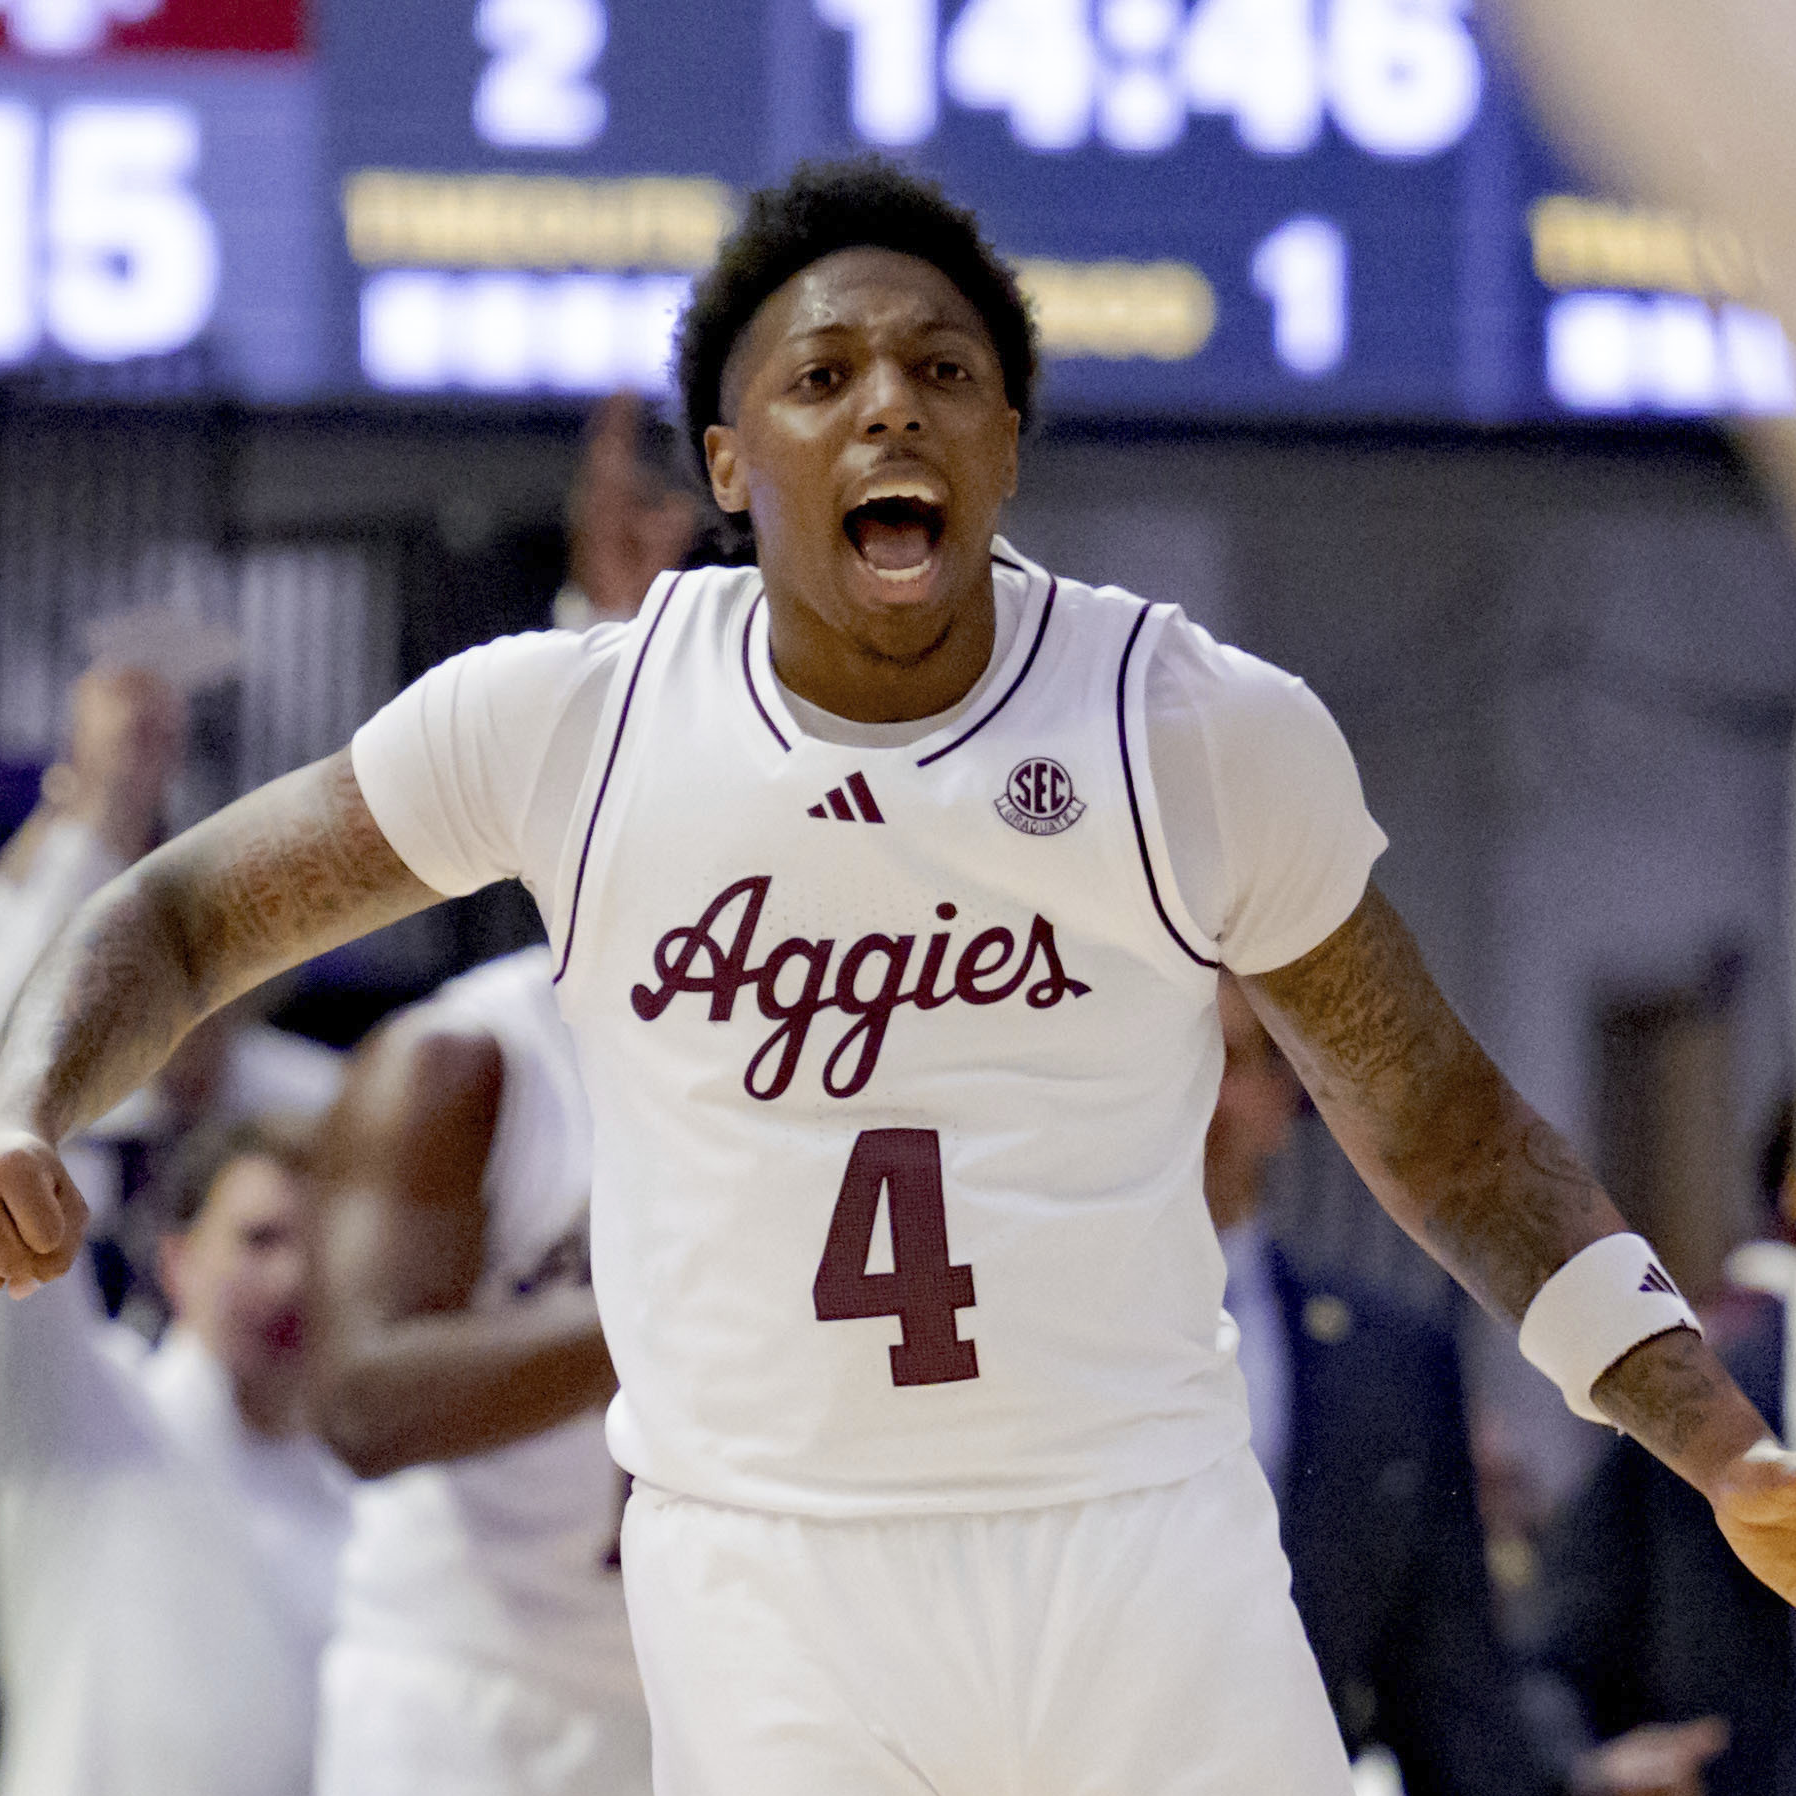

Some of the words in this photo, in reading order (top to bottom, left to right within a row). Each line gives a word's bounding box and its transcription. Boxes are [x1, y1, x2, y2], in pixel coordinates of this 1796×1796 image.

[472, 0, 607, 150] 2
[820, 0, 1483, 159] 14:46
[1252, 215, 1347, 378] 1
[1014, 762, 1066, 814] SEC
[630, 875, 1092, 1101] Aggies
[812, 1127, 980, 1387] 4
